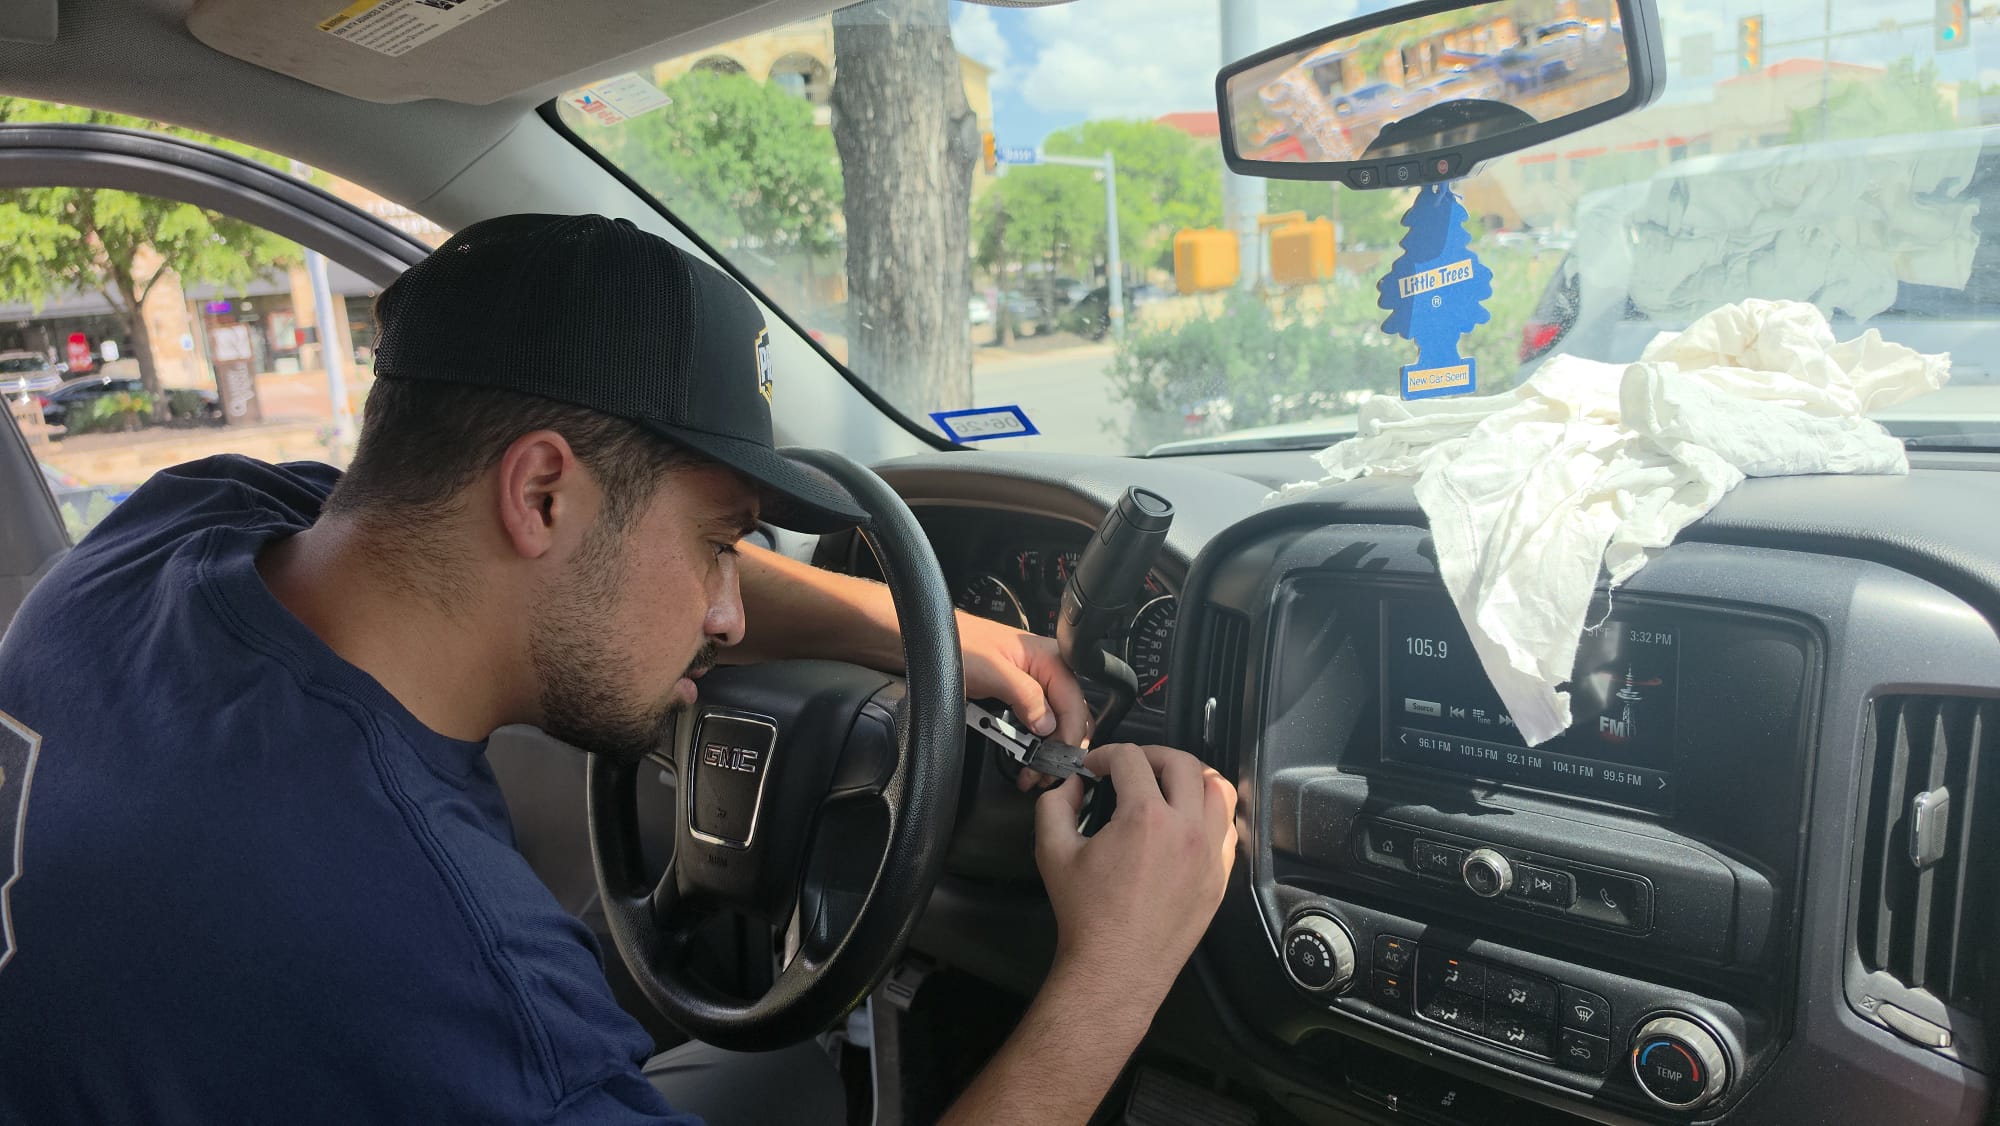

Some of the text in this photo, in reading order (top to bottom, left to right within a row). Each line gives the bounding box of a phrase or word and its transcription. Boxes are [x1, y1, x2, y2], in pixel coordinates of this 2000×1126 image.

[1403, 266, 1470, 295] Little Trees
[1409, 371, 1467, 387] New Car Scent
[1155, 629, 1168, 638] 40
[1630, 630, 1672, 646] 3:32 PM
[1150, 641, 1162, 650] 30
[1406, 636, 1448, 659] 105.9
[1148, 654, 1160, 663] 20
[1149, 668, 1159, 677] 10
[1412, 702, 1434, 713] Source
[1476, 715, 1491, 725] Tune
[1600, 715, 1625, 738] FM
[1418, 737, 1451, 753] 96.1 FM
[1460, 744, 1498, 761] 101.5 FM
[704, 744, 758, 772] GMC
[1506, 752, 1542, 769] 92.1 FM
[1552, 761, 1594, 778] 104.1 FM
[1603, 769, 1642, 787] 99.5 FM
[1385, 951, 1400, 963] A/C
[1656, 1065, 1683, 1082] TEMP
